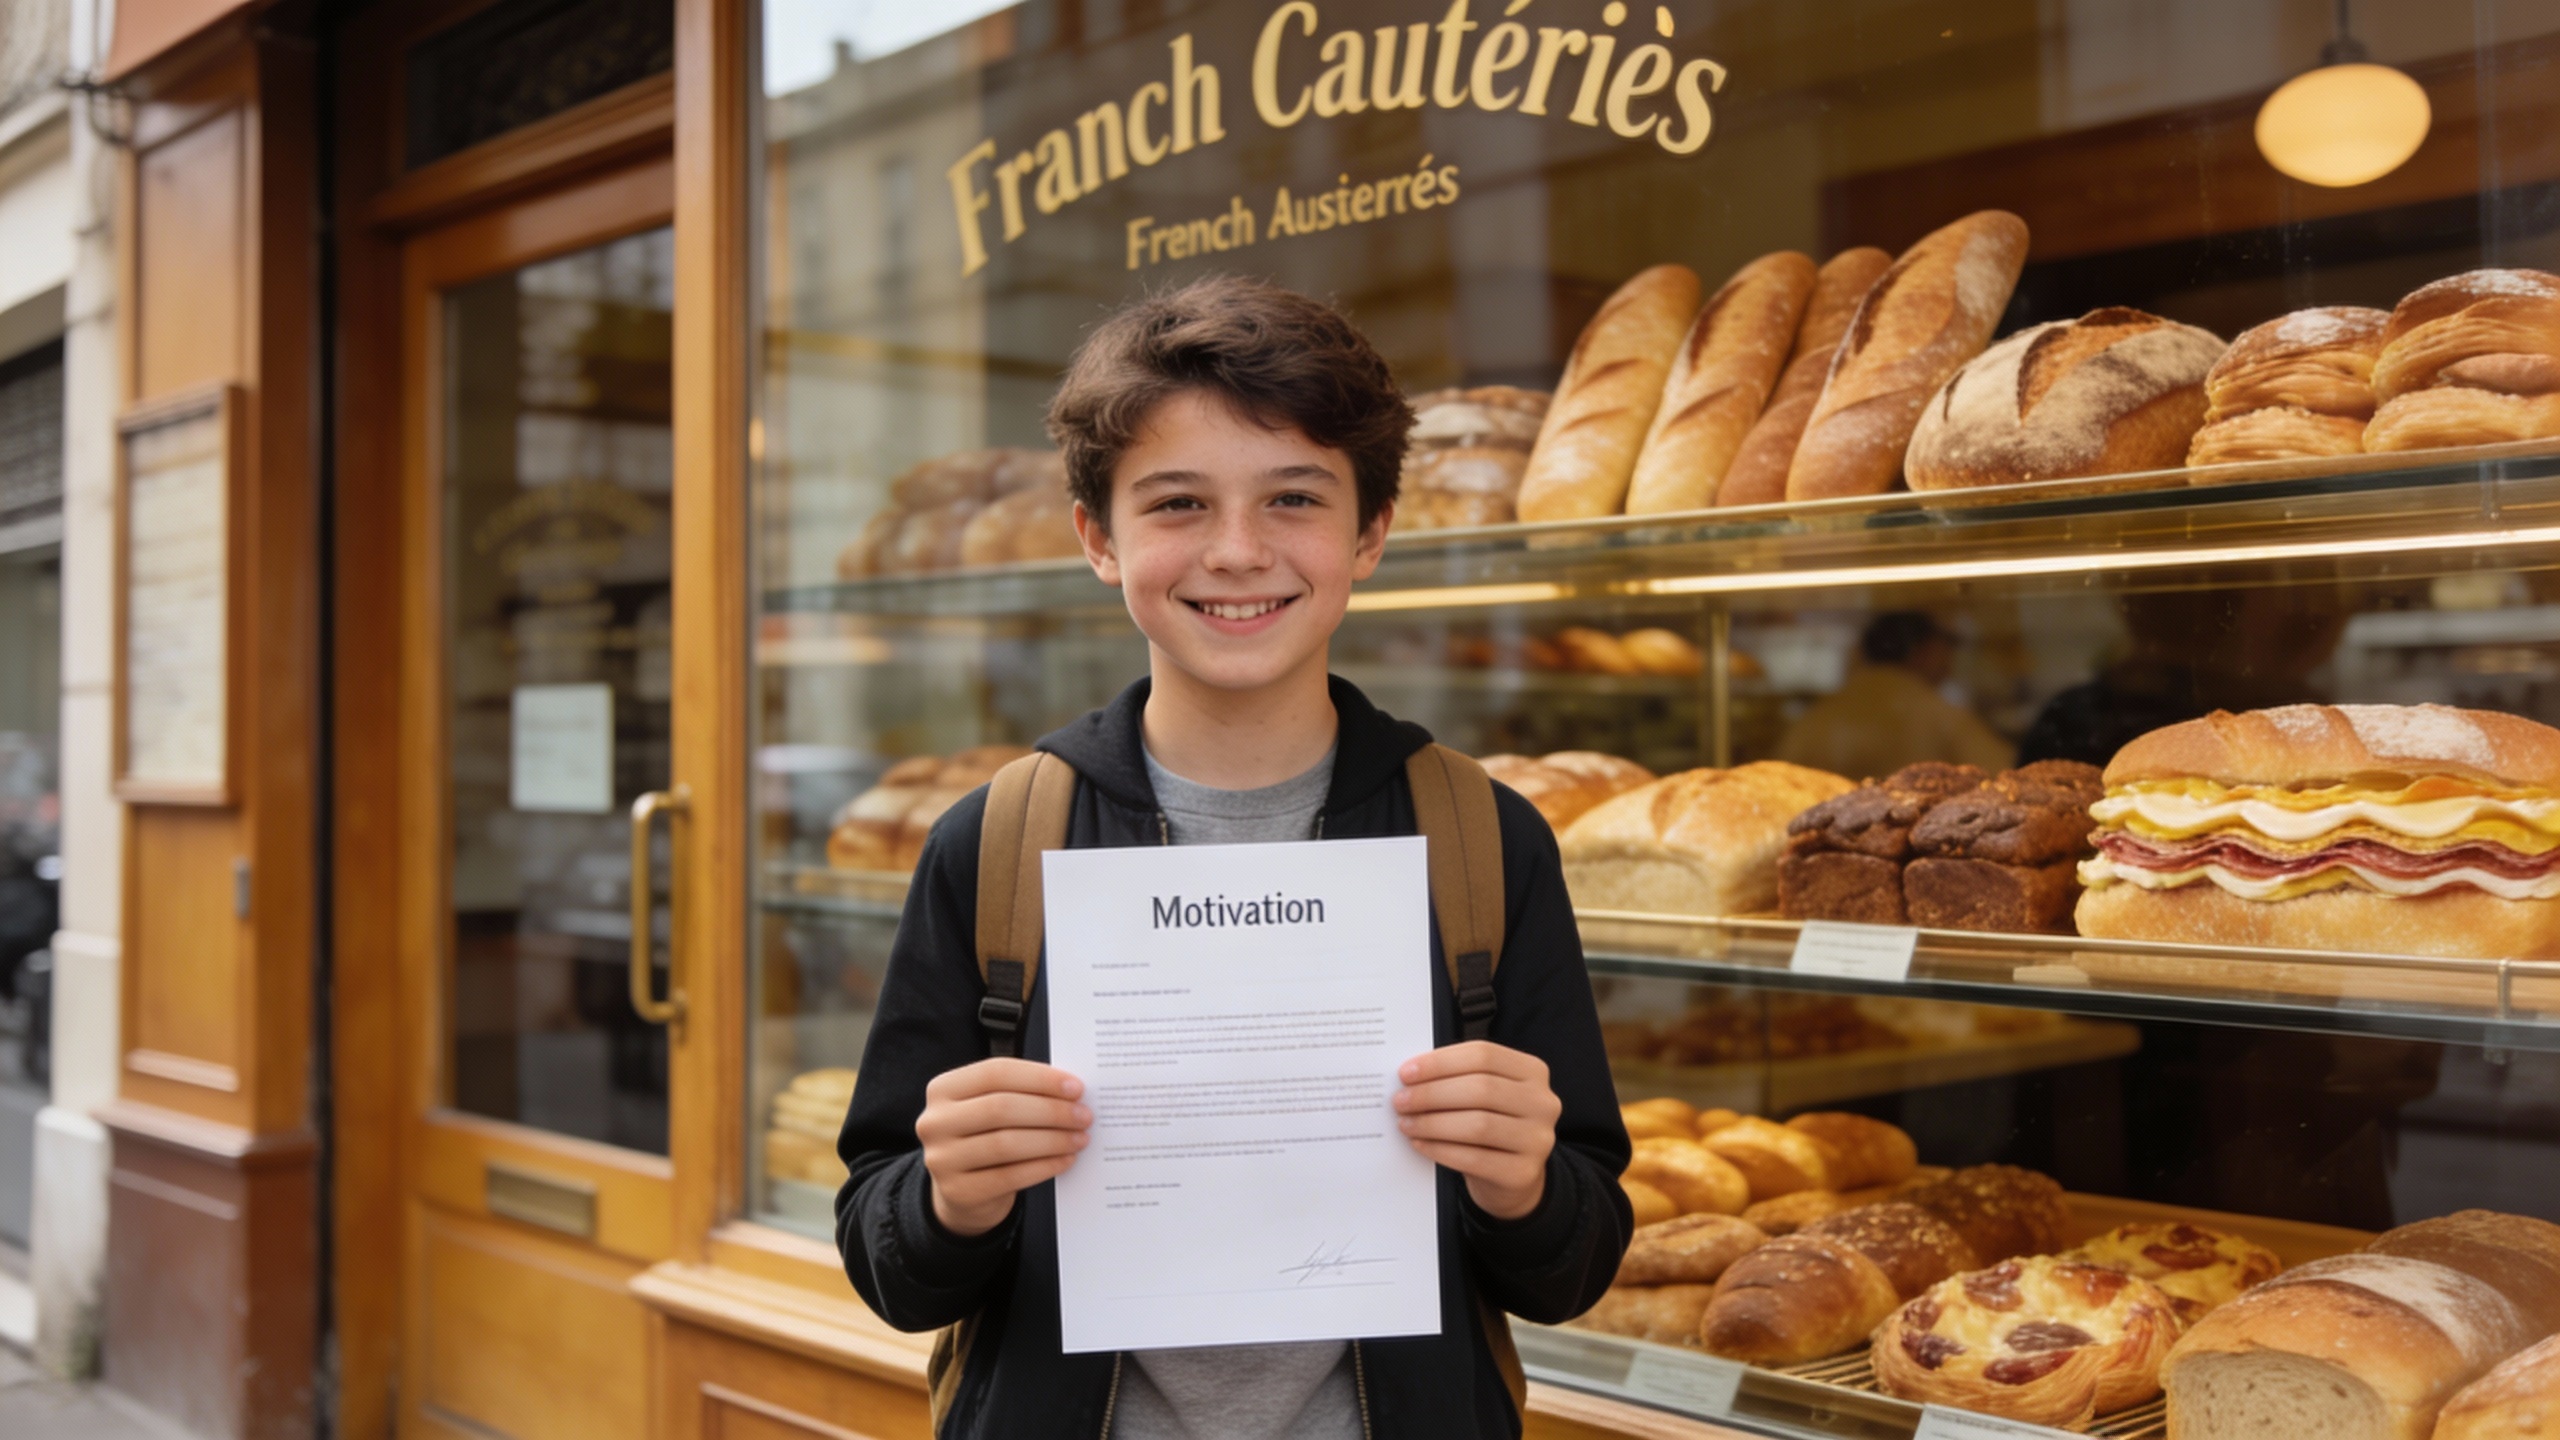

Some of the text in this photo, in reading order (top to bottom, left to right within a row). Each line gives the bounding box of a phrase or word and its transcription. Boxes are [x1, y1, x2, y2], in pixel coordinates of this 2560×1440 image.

[946, 32, 1226, 277] Franch
[1126, 195, 1255, 270] French
[1152, 891, 1325, 929] Motivation
